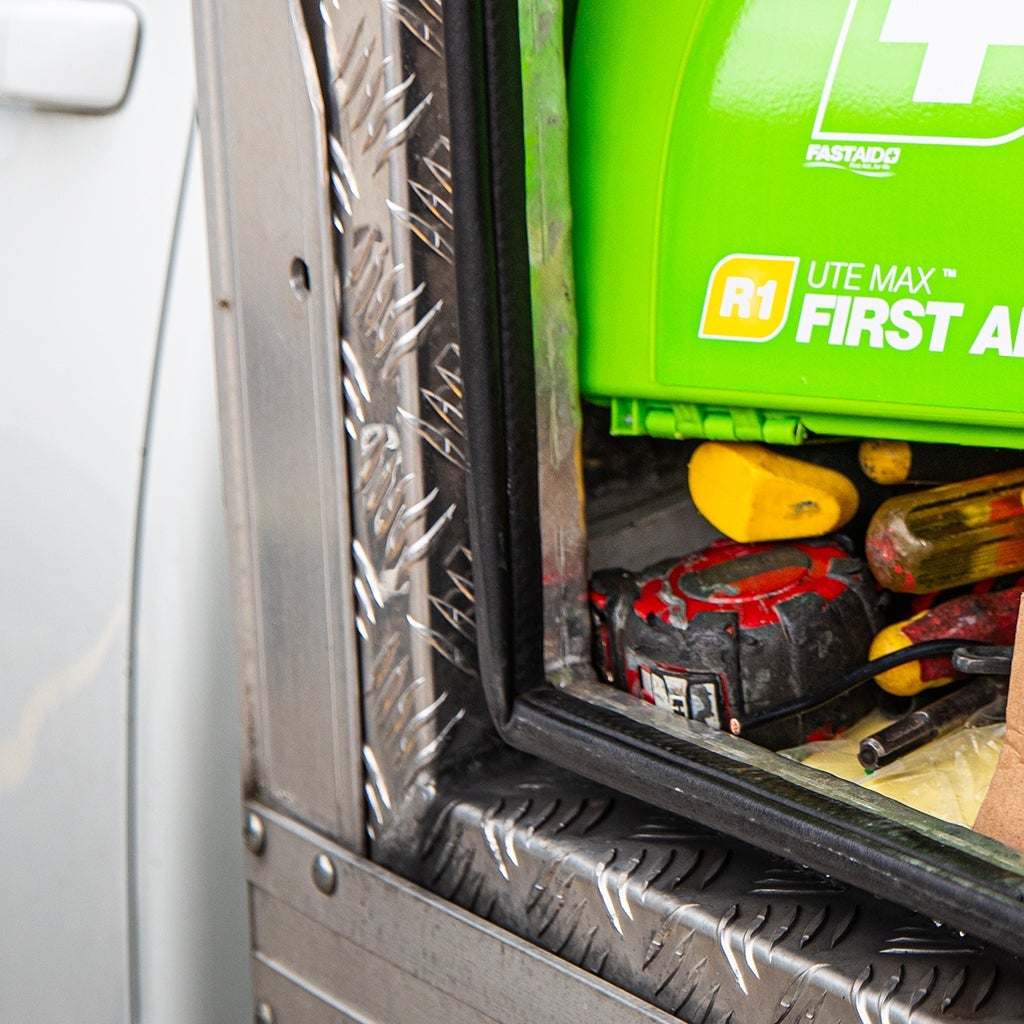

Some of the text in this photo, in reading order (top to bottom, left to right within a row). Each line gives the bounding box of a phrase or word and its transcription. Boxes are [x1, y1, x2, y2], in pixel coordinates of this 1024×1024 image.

[805, 144, 886, 164] FASTAID
[719, 275, 778, 320] R1
[807, 260, 866, 291] UTE
[869, 263, 936, 295] MAX
[795, 292, 965, 353] FIRST
